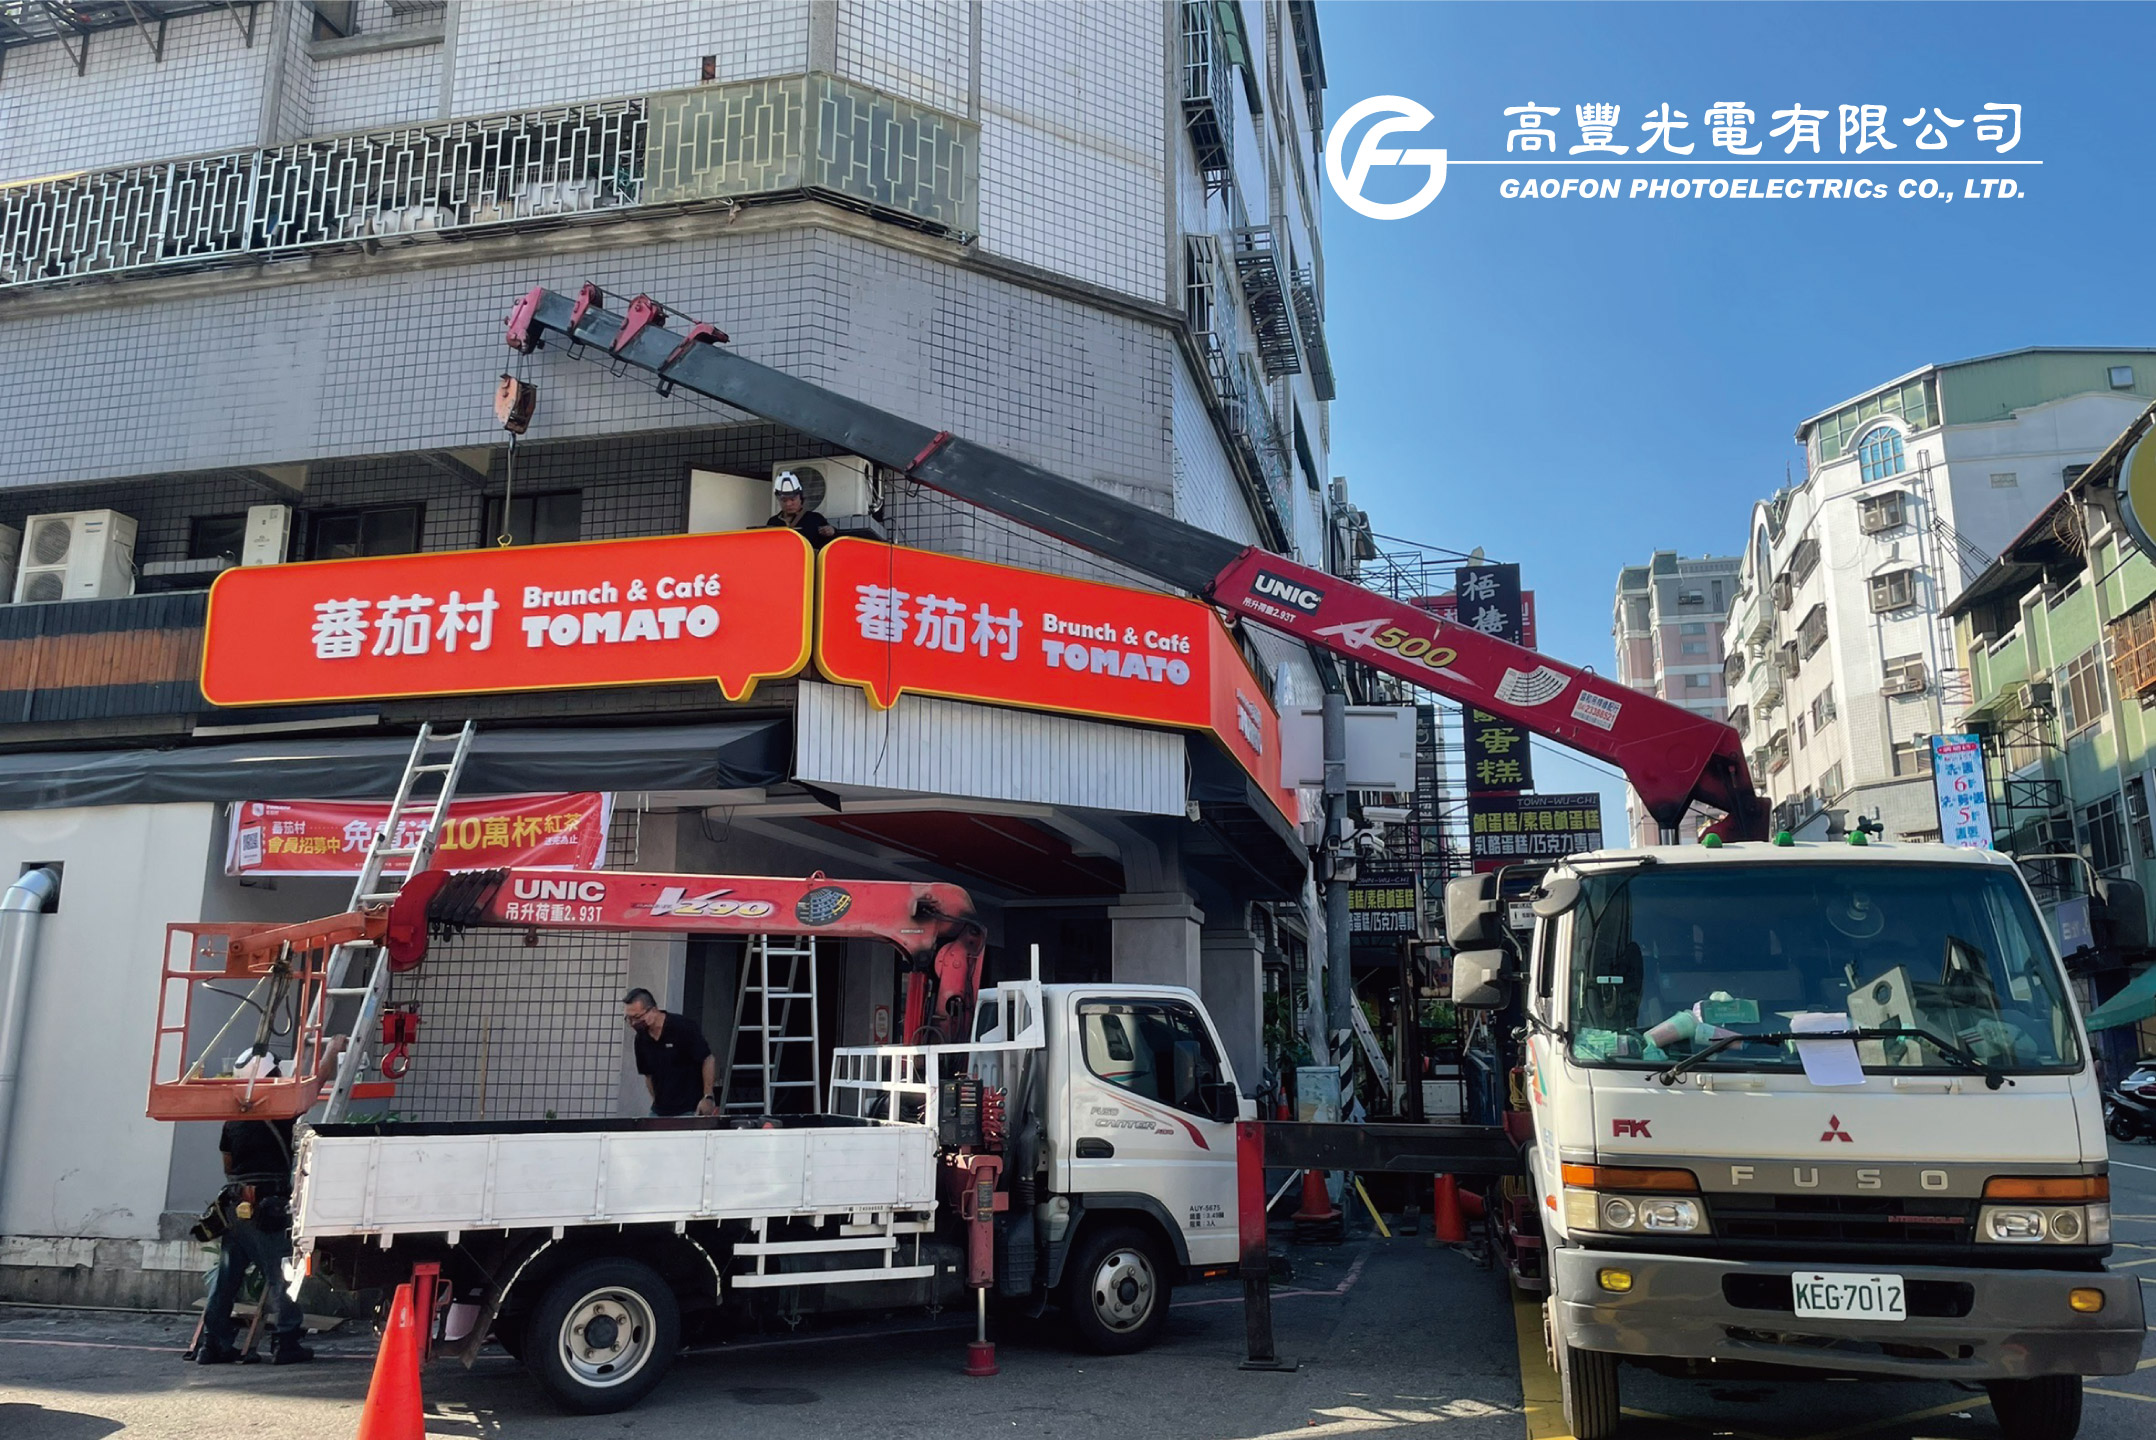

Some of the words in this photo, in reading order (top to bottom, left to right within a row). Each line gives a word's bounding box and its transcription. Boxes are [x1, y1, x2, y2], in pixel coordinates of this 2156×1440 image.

[524, 581, 618, 608] Brunch
[627, 579, 647, 601] &
[656, 574, 721, 599] Café
[1254, 575, 1321, 610] UNIC
[312, 588, 500, 658] 蕃茄村
[522, 604, 720, 648] TOMATO
[855, 584, 1023, 661] 蕃茄村
[1042, 613, 1118, 642] Brunch
[1122, 627, 1139, 646] &
[1144, 630, 1190, 654] Café
[1041, 639, 1190, 685] TOMATO
[1517, 796, 1597, 806] TOWN-WU-CHI
[268, 836, 341, 854] 會員招募中
[440, 815, 543, 850] 10萬杯
[544, 813, 583, 833] 紅茶
[514, 879, 606, 901] UNIC
[1095, 1118, 1156, 1130] CANTER
[1612, 1119, 1652, 1139] FK
[1731, 1165, 1949, 1191] FUSO
